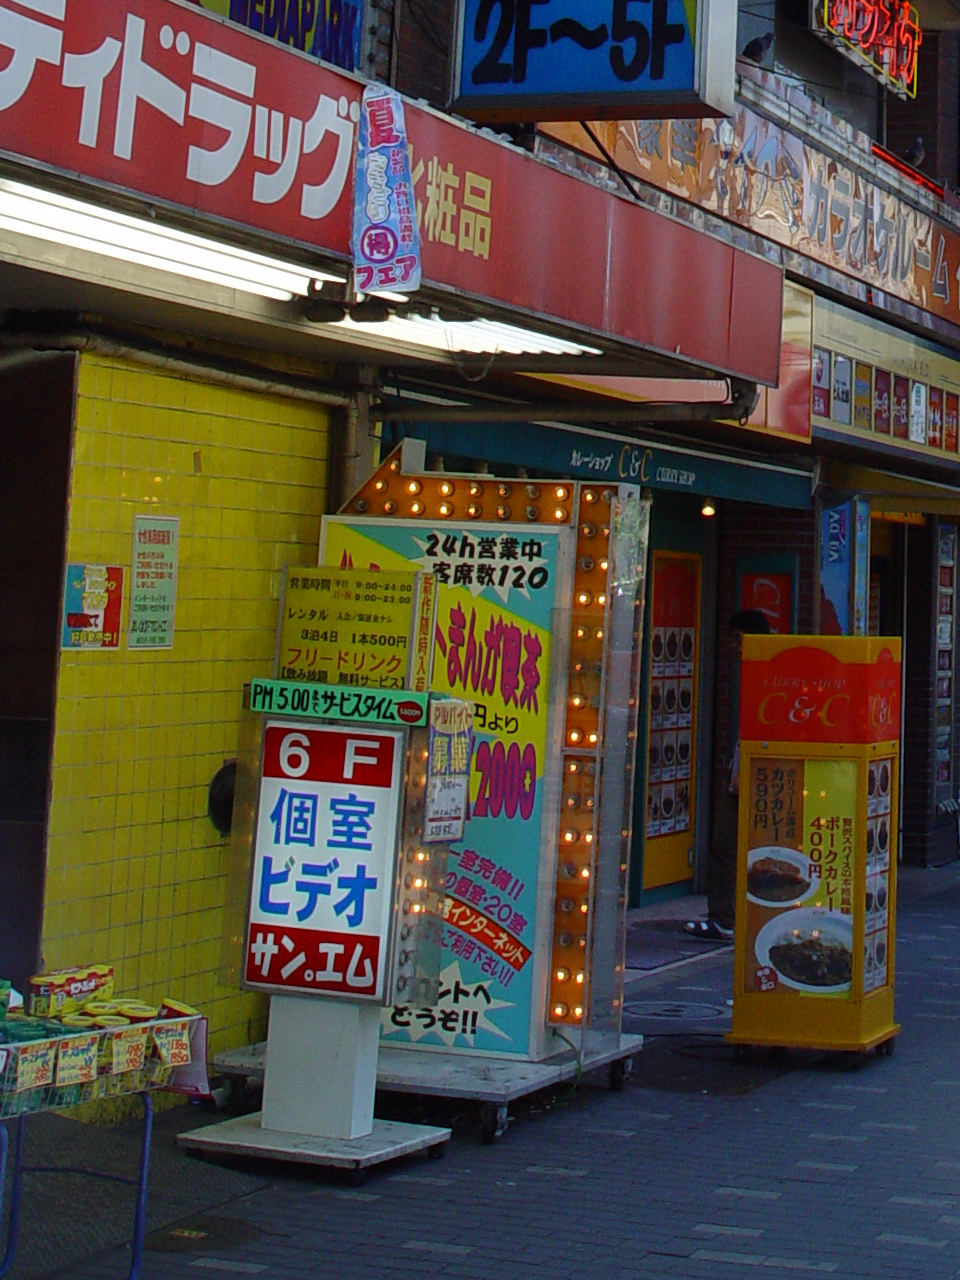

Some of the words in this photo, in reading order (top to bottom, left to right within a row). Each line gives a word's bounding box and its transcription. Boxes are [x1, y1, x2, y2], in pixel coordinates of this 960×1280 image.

[364, 94, 401, 150] 夏
[808, 166, 950, 305] カラオケルーム
[355, 254, 418, 290] フェア
[618, 444, 653, 483] C&C
[425, 533, 543, 562] 24h営業中
[290, 577, 331, 592] 営業時間
[287, 607, 329, 621] レンタル
[300, 628, 338, 643] 3泊4日
[351, 632, 407, 649] 1本500円
[286, 647, 402, 674] フリードリンク
[252, 682, 274, 710] PM
[321, 690, 397, 721] サービスタイム
[757, 691, 851, 728] C&C
[753, 766, 769, 830] 590円
[771, 766, 785, 844] カツカレー
[270, 787, 377, 852] 個室
[807, 815, 824, 880] 400円
[824, 815, 841, 913] ポークカレー
[258, 855, 378, 923] ビデオ
[390, 1005, 479, 1035] どうぞ!!
